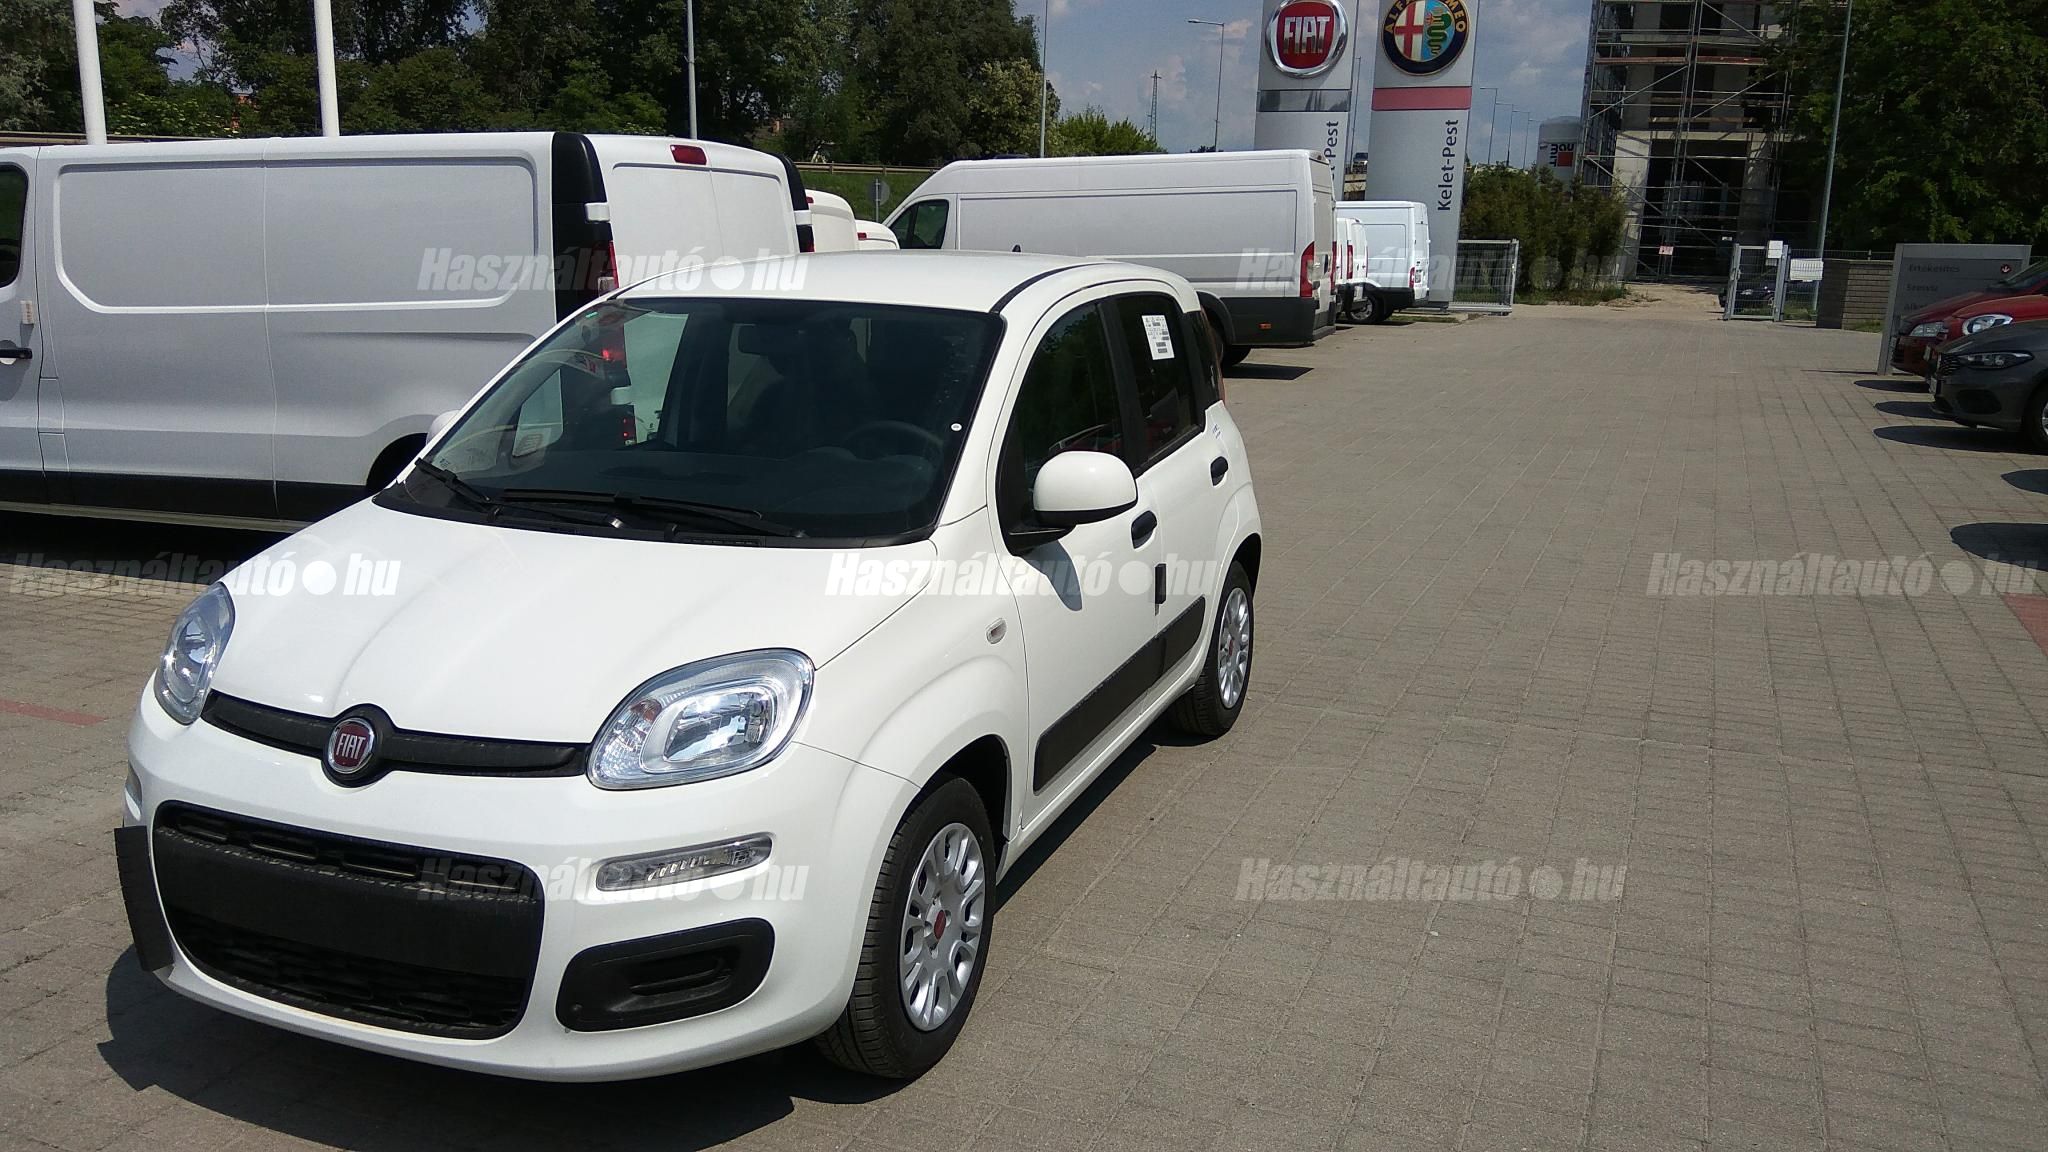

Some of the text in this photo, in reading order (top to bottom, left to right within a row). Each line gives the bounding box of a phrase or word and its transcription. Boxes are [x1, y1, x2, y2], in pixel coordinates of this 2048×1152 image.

[1283, 15, 1331, 55] FIAT
[1437, 119, 1459, 211] Kelet-Pest
[335, 733, 367, 760] FIAT
